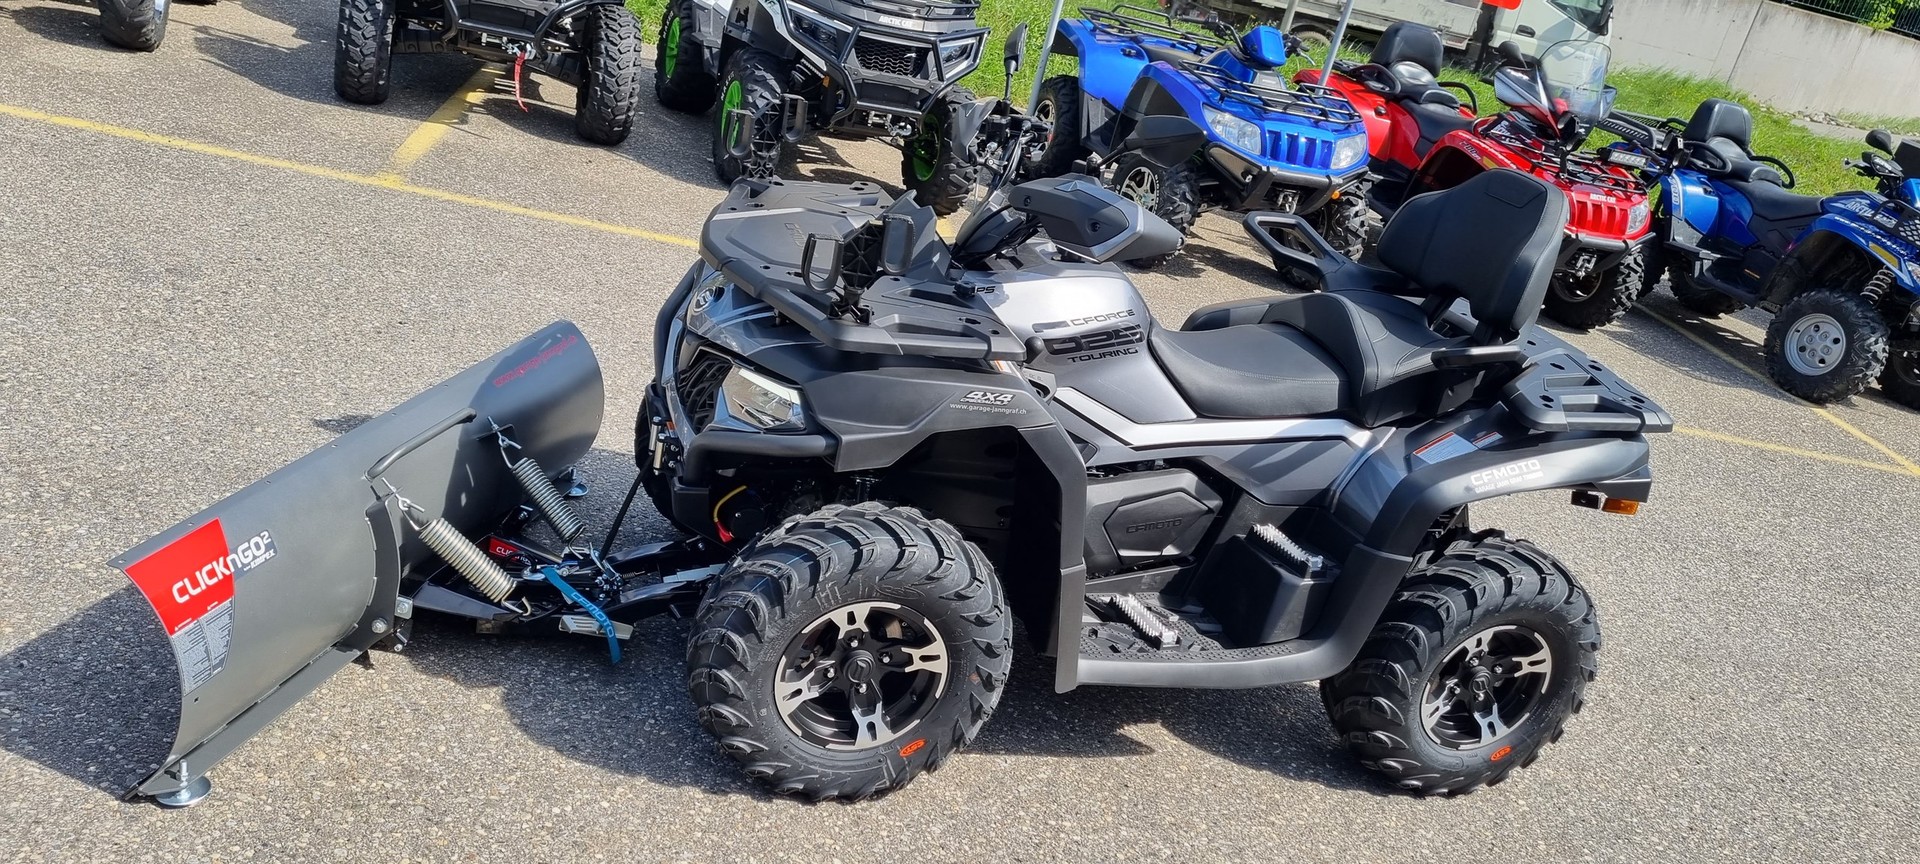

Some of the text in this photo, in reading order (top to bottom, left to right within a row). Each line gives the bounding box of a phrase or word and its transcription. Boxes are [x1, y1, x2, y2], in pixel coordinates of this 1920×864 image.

[1070, 309, 1135, 326] CFORCE
[1067, 347, 1139, 363] TOURING
[949, 402, 1027, 415] www.garage-janngraf.ch
[1470, 459, 1541, 486] CFMOTO
[1125, 517, 1183, 534] CFMOTO
[570, 591, 615, 638] CFMOTO
